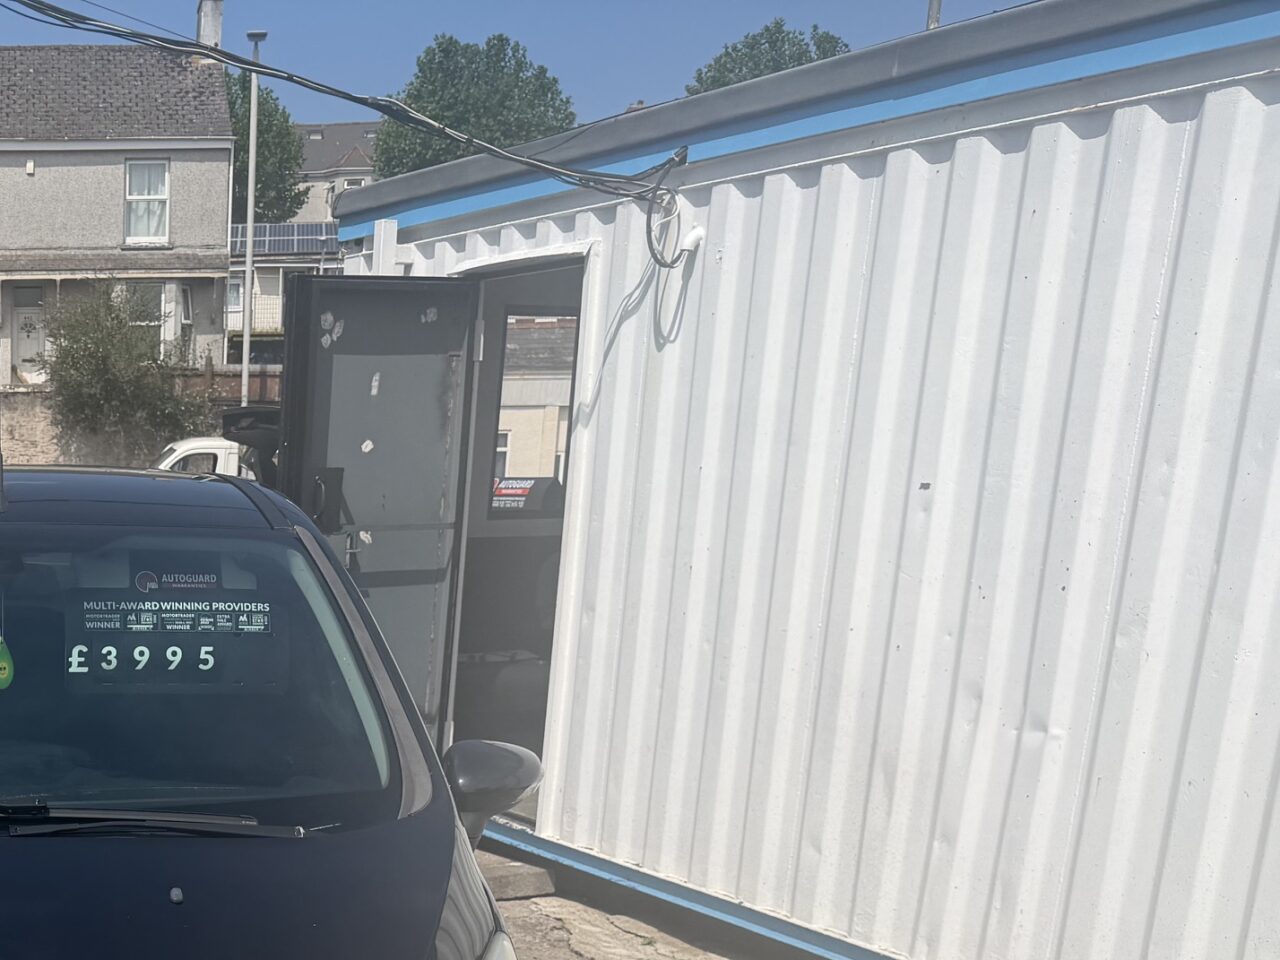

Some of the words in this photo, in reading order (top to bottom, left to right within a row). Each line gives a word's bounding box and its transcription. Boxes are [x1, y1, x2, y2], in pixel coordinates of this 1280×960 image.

[161, 574, 217, 583] AUTOGUARD
[83, 602, 160, 611] MULTI-AWARD
[160, 602, 210, 611] WINNING
[212, 602, 270, 612] PROVIDERS
